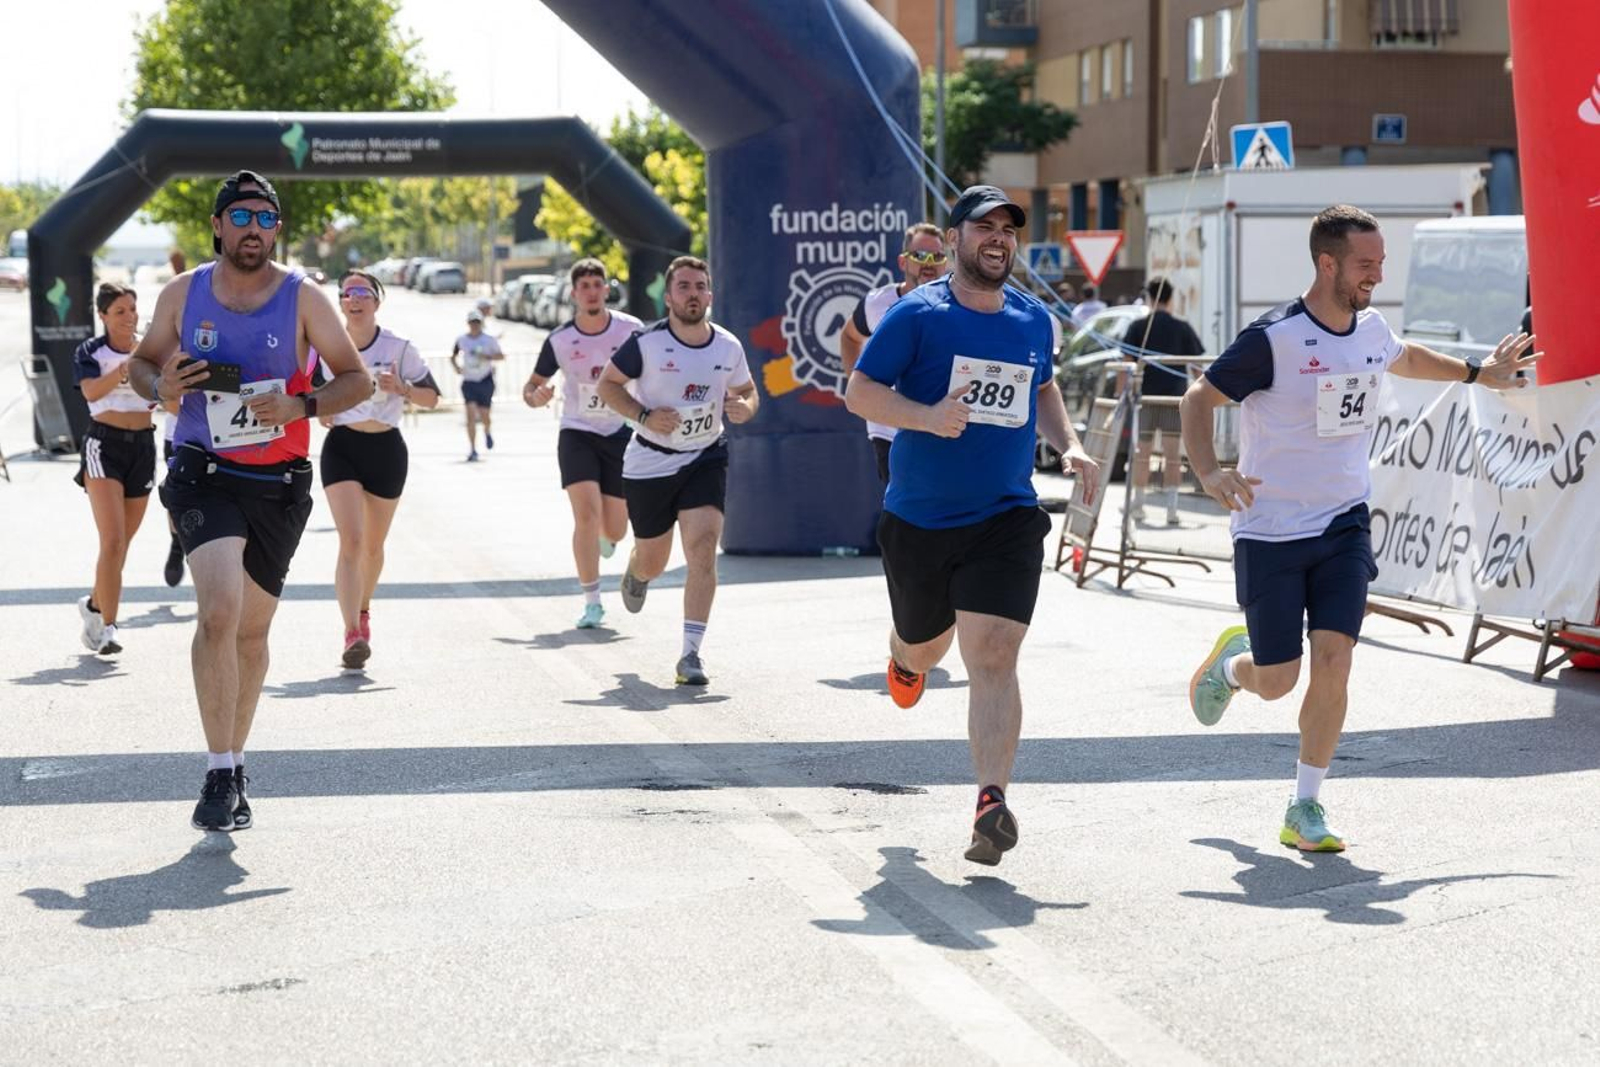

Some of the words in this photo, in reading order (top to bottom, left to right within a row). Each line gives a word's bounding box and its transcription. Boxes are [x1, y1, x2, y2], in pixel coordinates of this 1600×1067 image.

[312, 137, 367, 149] Patronato
[369, 137, 424, 151] Municipal
[425, 137, 441, 149] de
[312, 151, 365, 165] Deportes
[366, 151, 382, 163] de
[769, 202, 908, 235] fundación
[796, 233, 887, 267] mupol
[962, 380, 1016, 409] 389
[1339, 392, 1367, 419] 54
[681, 413, 714, 436] 370
